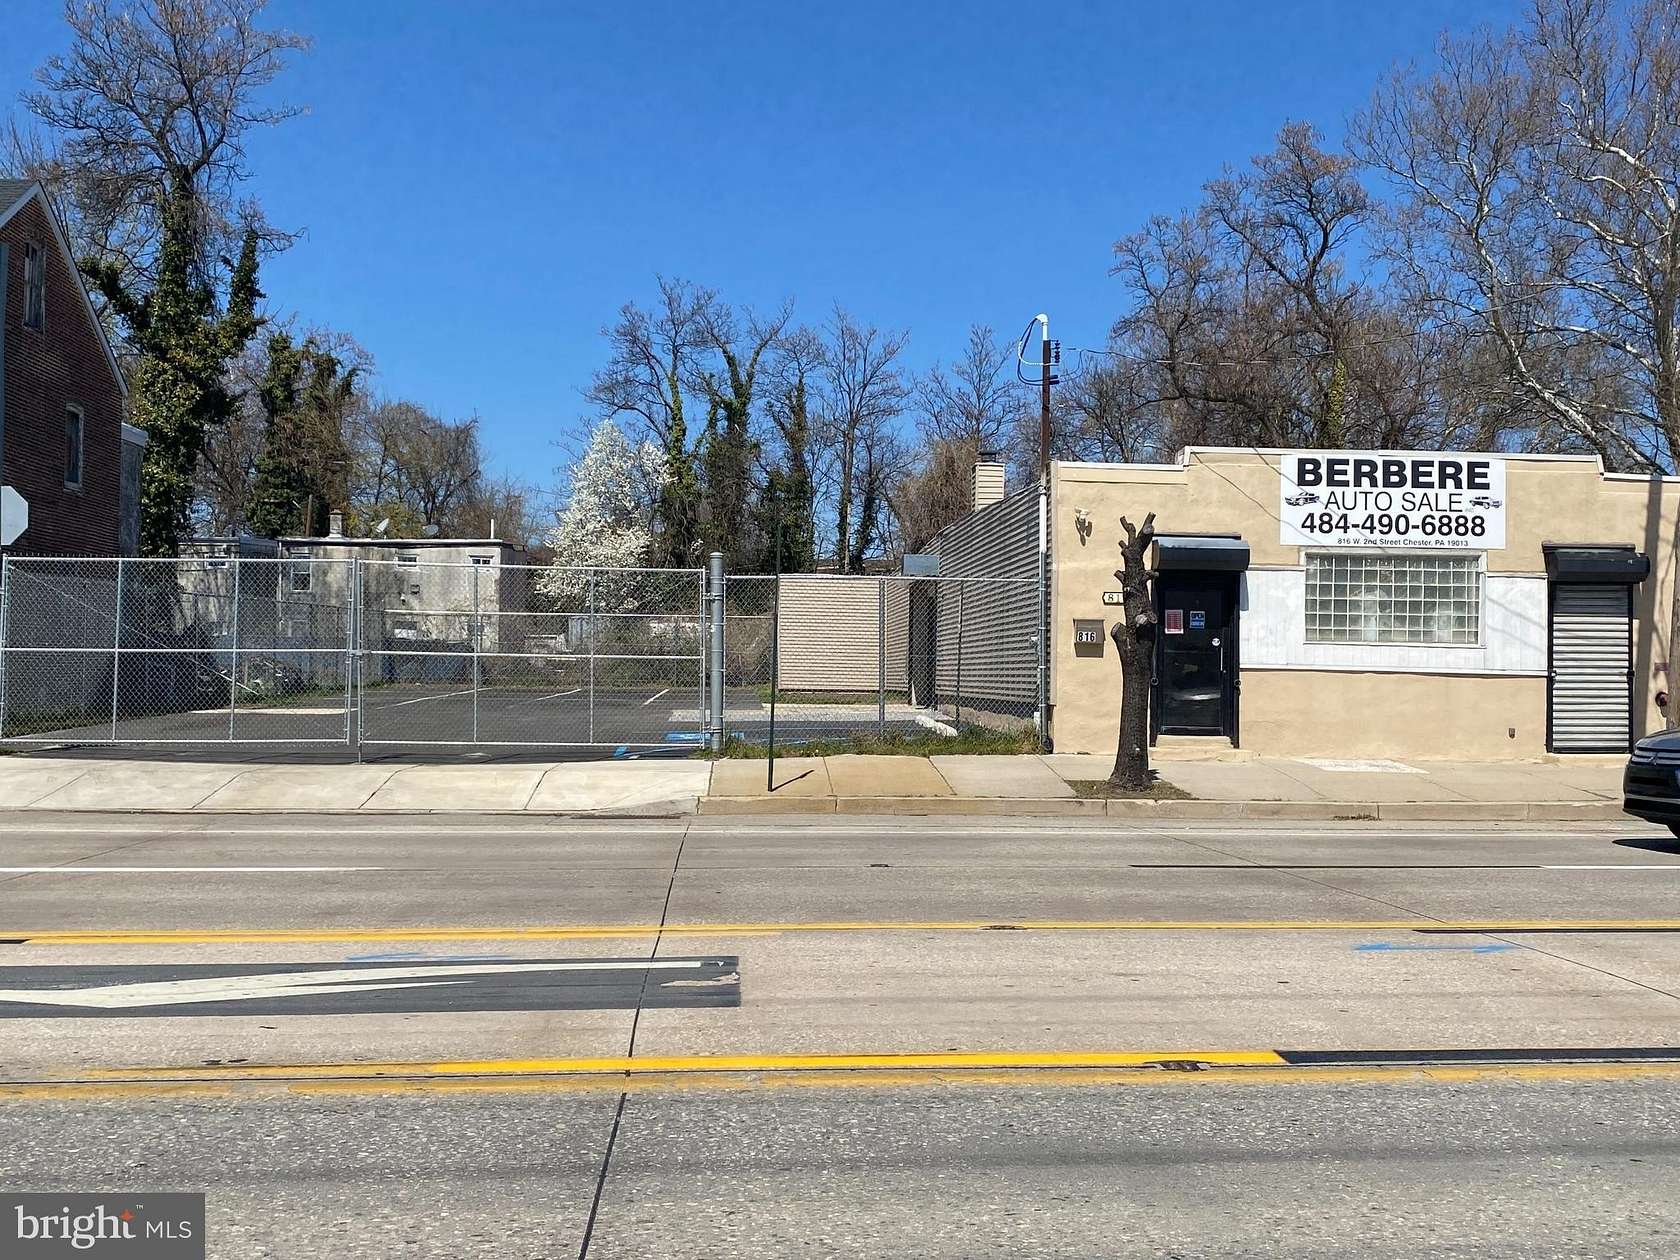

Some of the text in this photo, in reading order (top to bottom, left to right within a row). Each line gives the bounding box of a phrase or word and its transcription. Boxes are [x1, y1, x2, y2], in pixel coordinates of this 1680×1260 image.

[1297, 458, 1491, 490] BERBERE
[1325, 491, 1463, 513] AUTO SALE
[1301, 512, 1486, 537] 484-490-6888
[1379, 538, 1401, 546] Street
[1107, 593, 1120, 603] 81
[1077, 631, 1096, 643] 816
